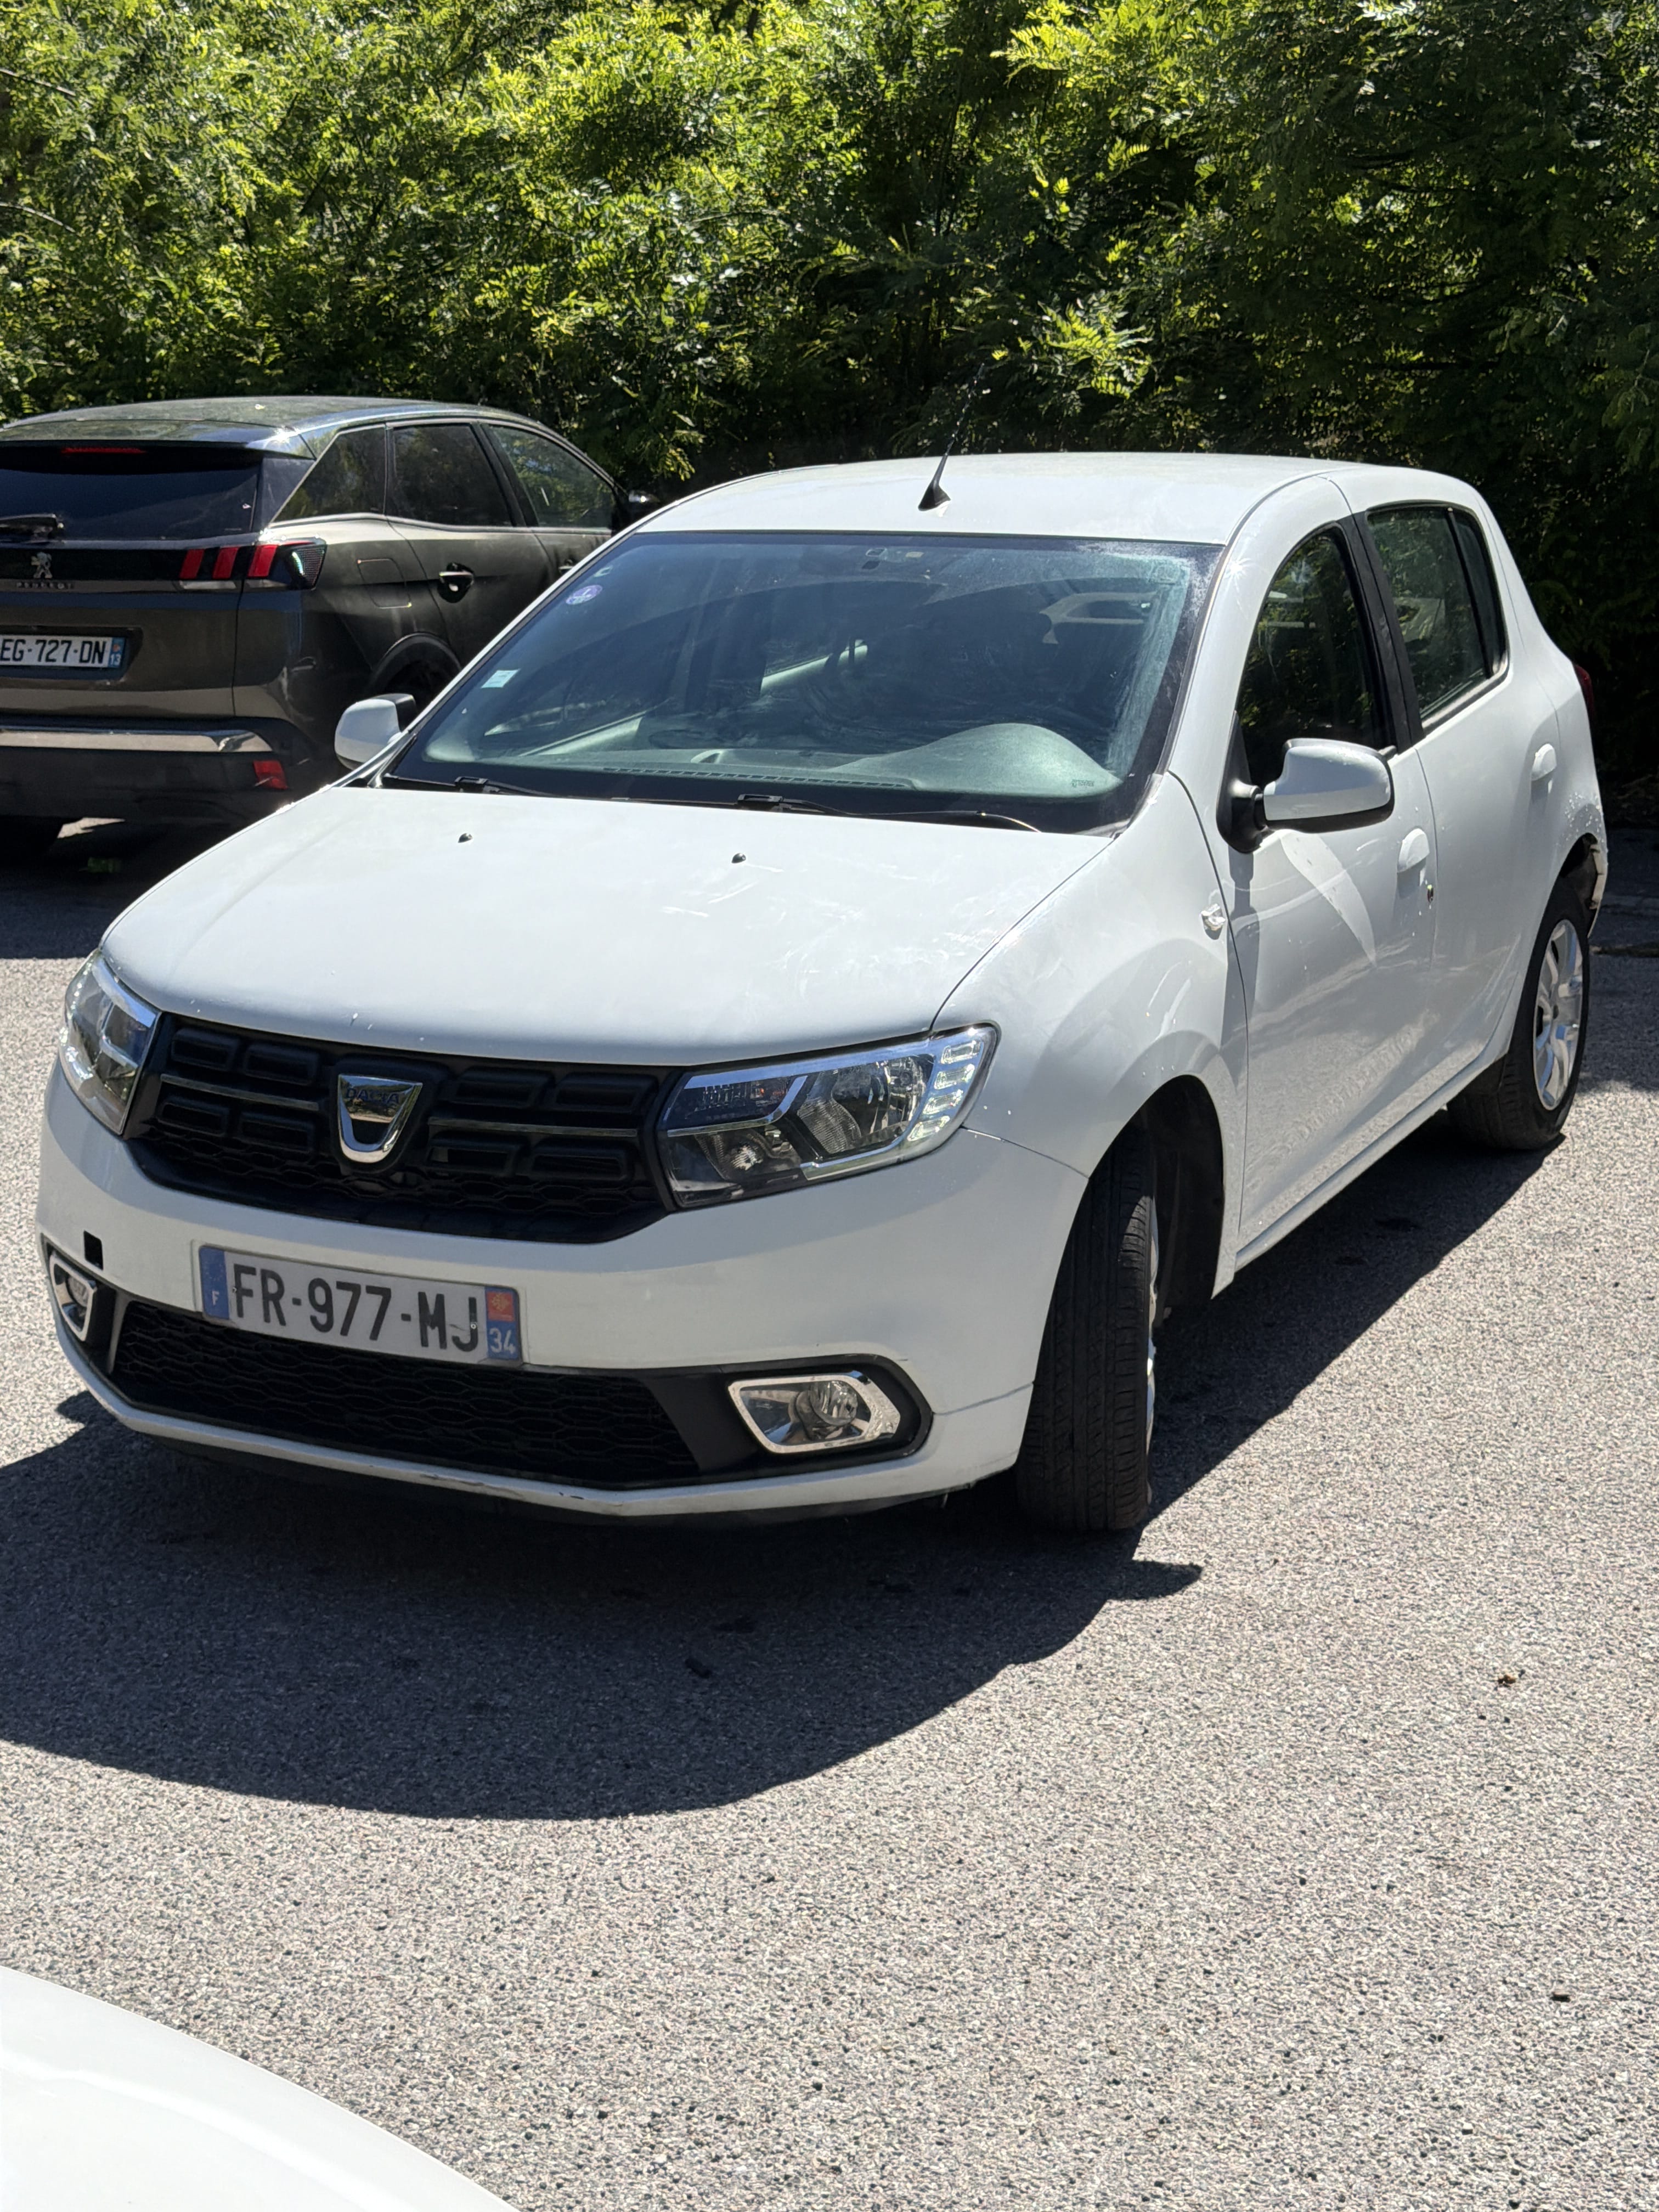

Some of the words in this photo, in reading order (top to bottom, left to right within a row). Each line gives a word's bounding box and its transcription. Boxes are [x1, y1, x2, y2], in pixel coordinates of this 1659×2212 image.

[1, 639, 106, 664] EG-727-DN
[110, 654, 121, 667] 13
[212, 1290, 219, 1306] F
[233, 1263, 478, 1352] FR-977-MJ
[489, 1328, 516, 1355] 34
